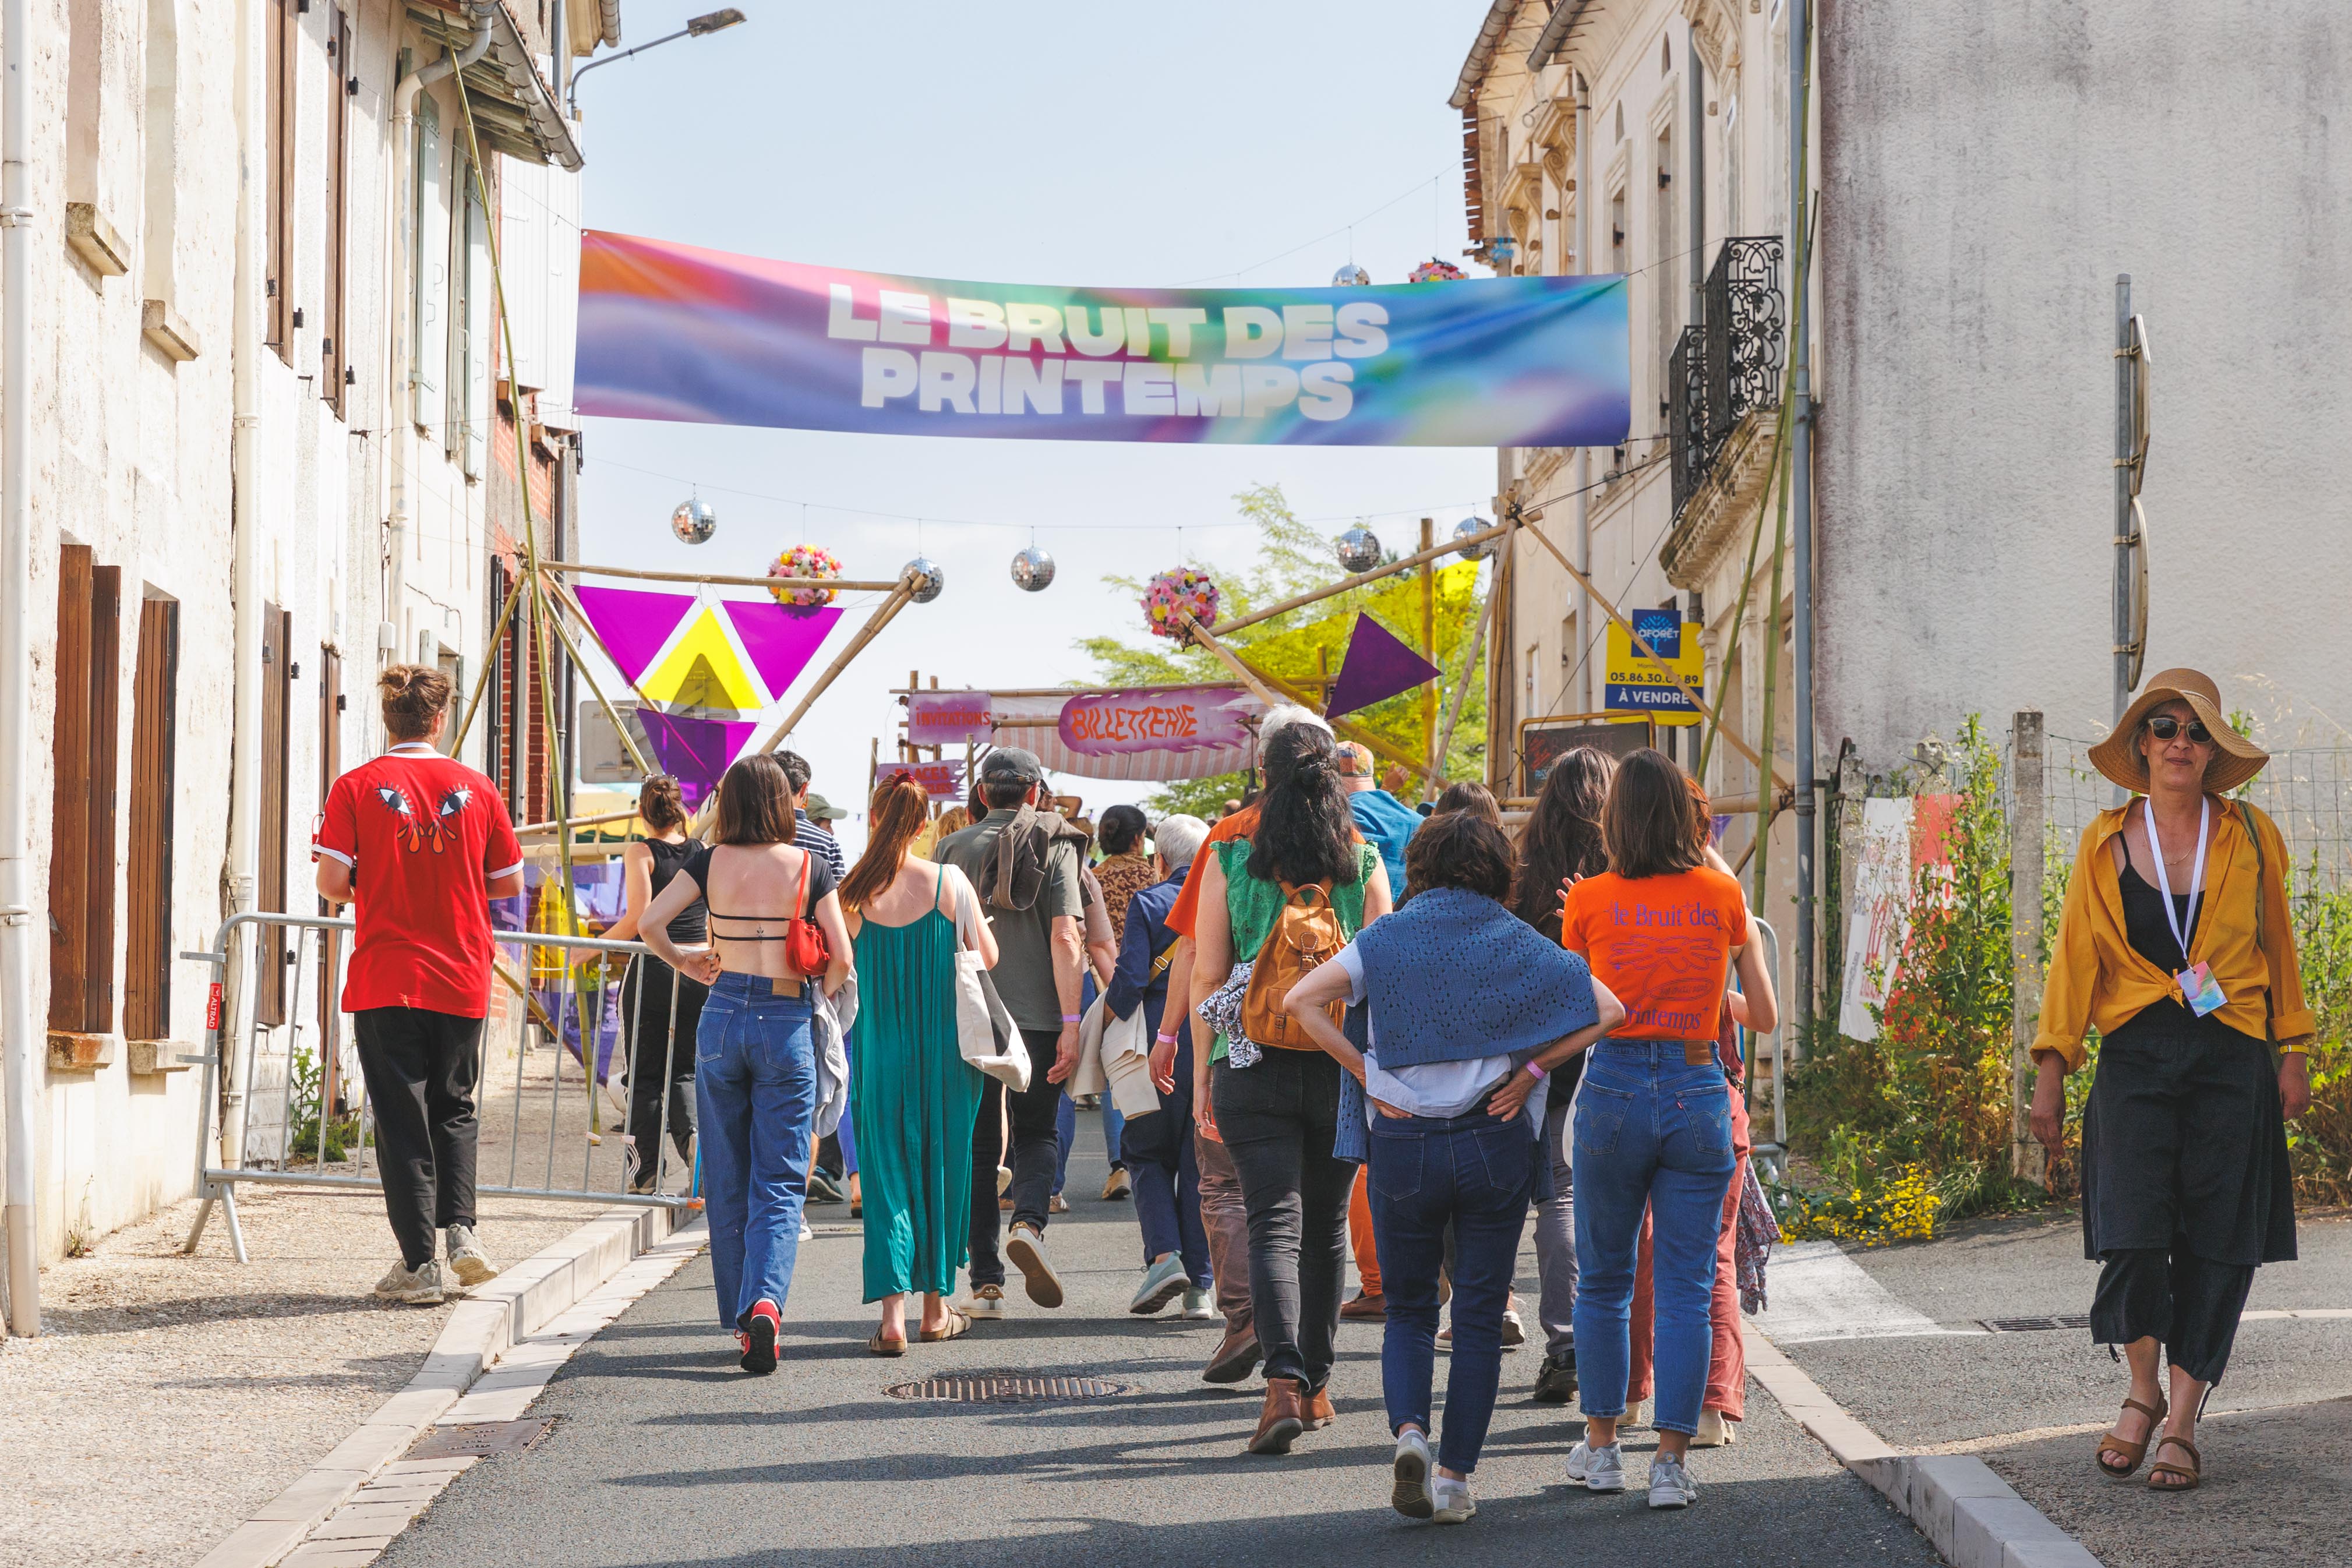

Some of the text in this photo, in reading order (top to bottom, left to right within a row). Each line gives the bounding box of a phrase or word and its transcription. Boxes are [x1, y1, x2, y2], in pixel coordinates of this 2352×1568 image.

[827, 282, 1389, 361] LE BRUIT DES
[861, 347, 1355, 422] PRINTEMPS
[1618, 687, 1690, 705] À VENDRE
[1071, 704, 1199, 742] BILLETTERIE
[1635, 903, 1683, 927] Bruit
[1689, 902, 1719, 927] des
[209, 997, 217, 1027] ALTRAD
